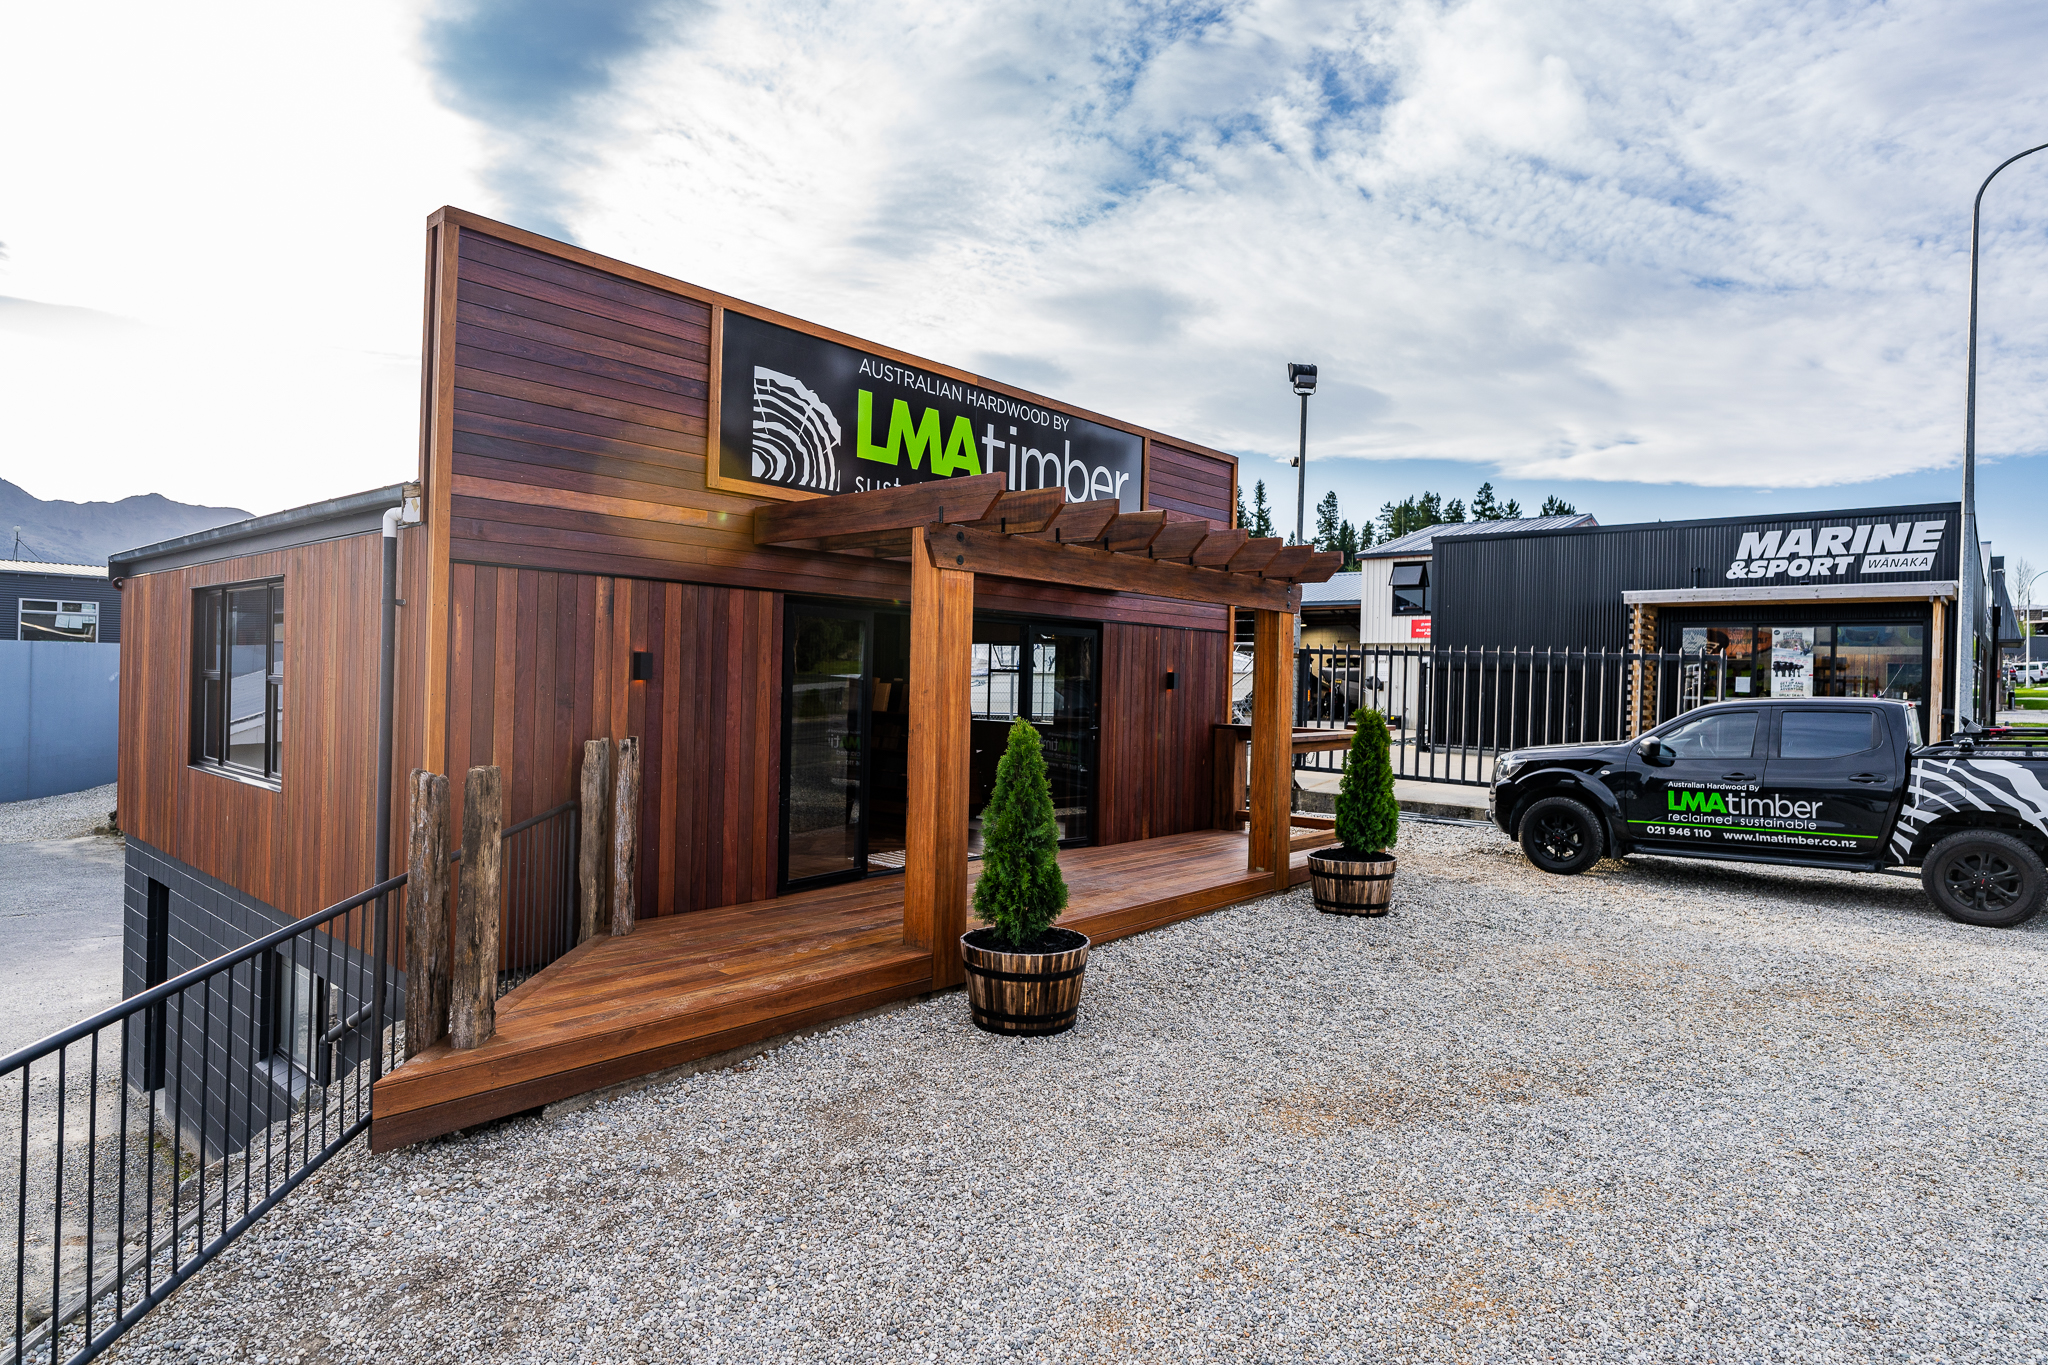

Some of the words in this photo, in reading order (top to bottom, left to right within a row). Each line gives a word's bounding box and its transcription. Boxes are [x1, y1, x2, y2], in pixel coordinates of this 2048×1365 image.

[858, 358, 962, 401] AUSTRALIAN
[967, 389, 1050, 427] HARDWOOD
[1053, 414, 1070, 432] BY
[1735, 519, 1947, 560] MARINE
[1725, 556, 1856, 580] &SPORT
[1667, 781, 1705, 789] Australian
[1707, 782, 1747, 791] Hardwood
[1749, 784, 1760, 792] By
[1668, 812, 1732, 825] reclaimed
[1740, 817, 1817, 830] sustainable
[1646, 826, 1665, 835] 021
[1668, 827, 1691, 837] 946
[1693, 829, 1712, 838] 110
[1723, 831, 1857, 848] www.lmatimber.co.nz
